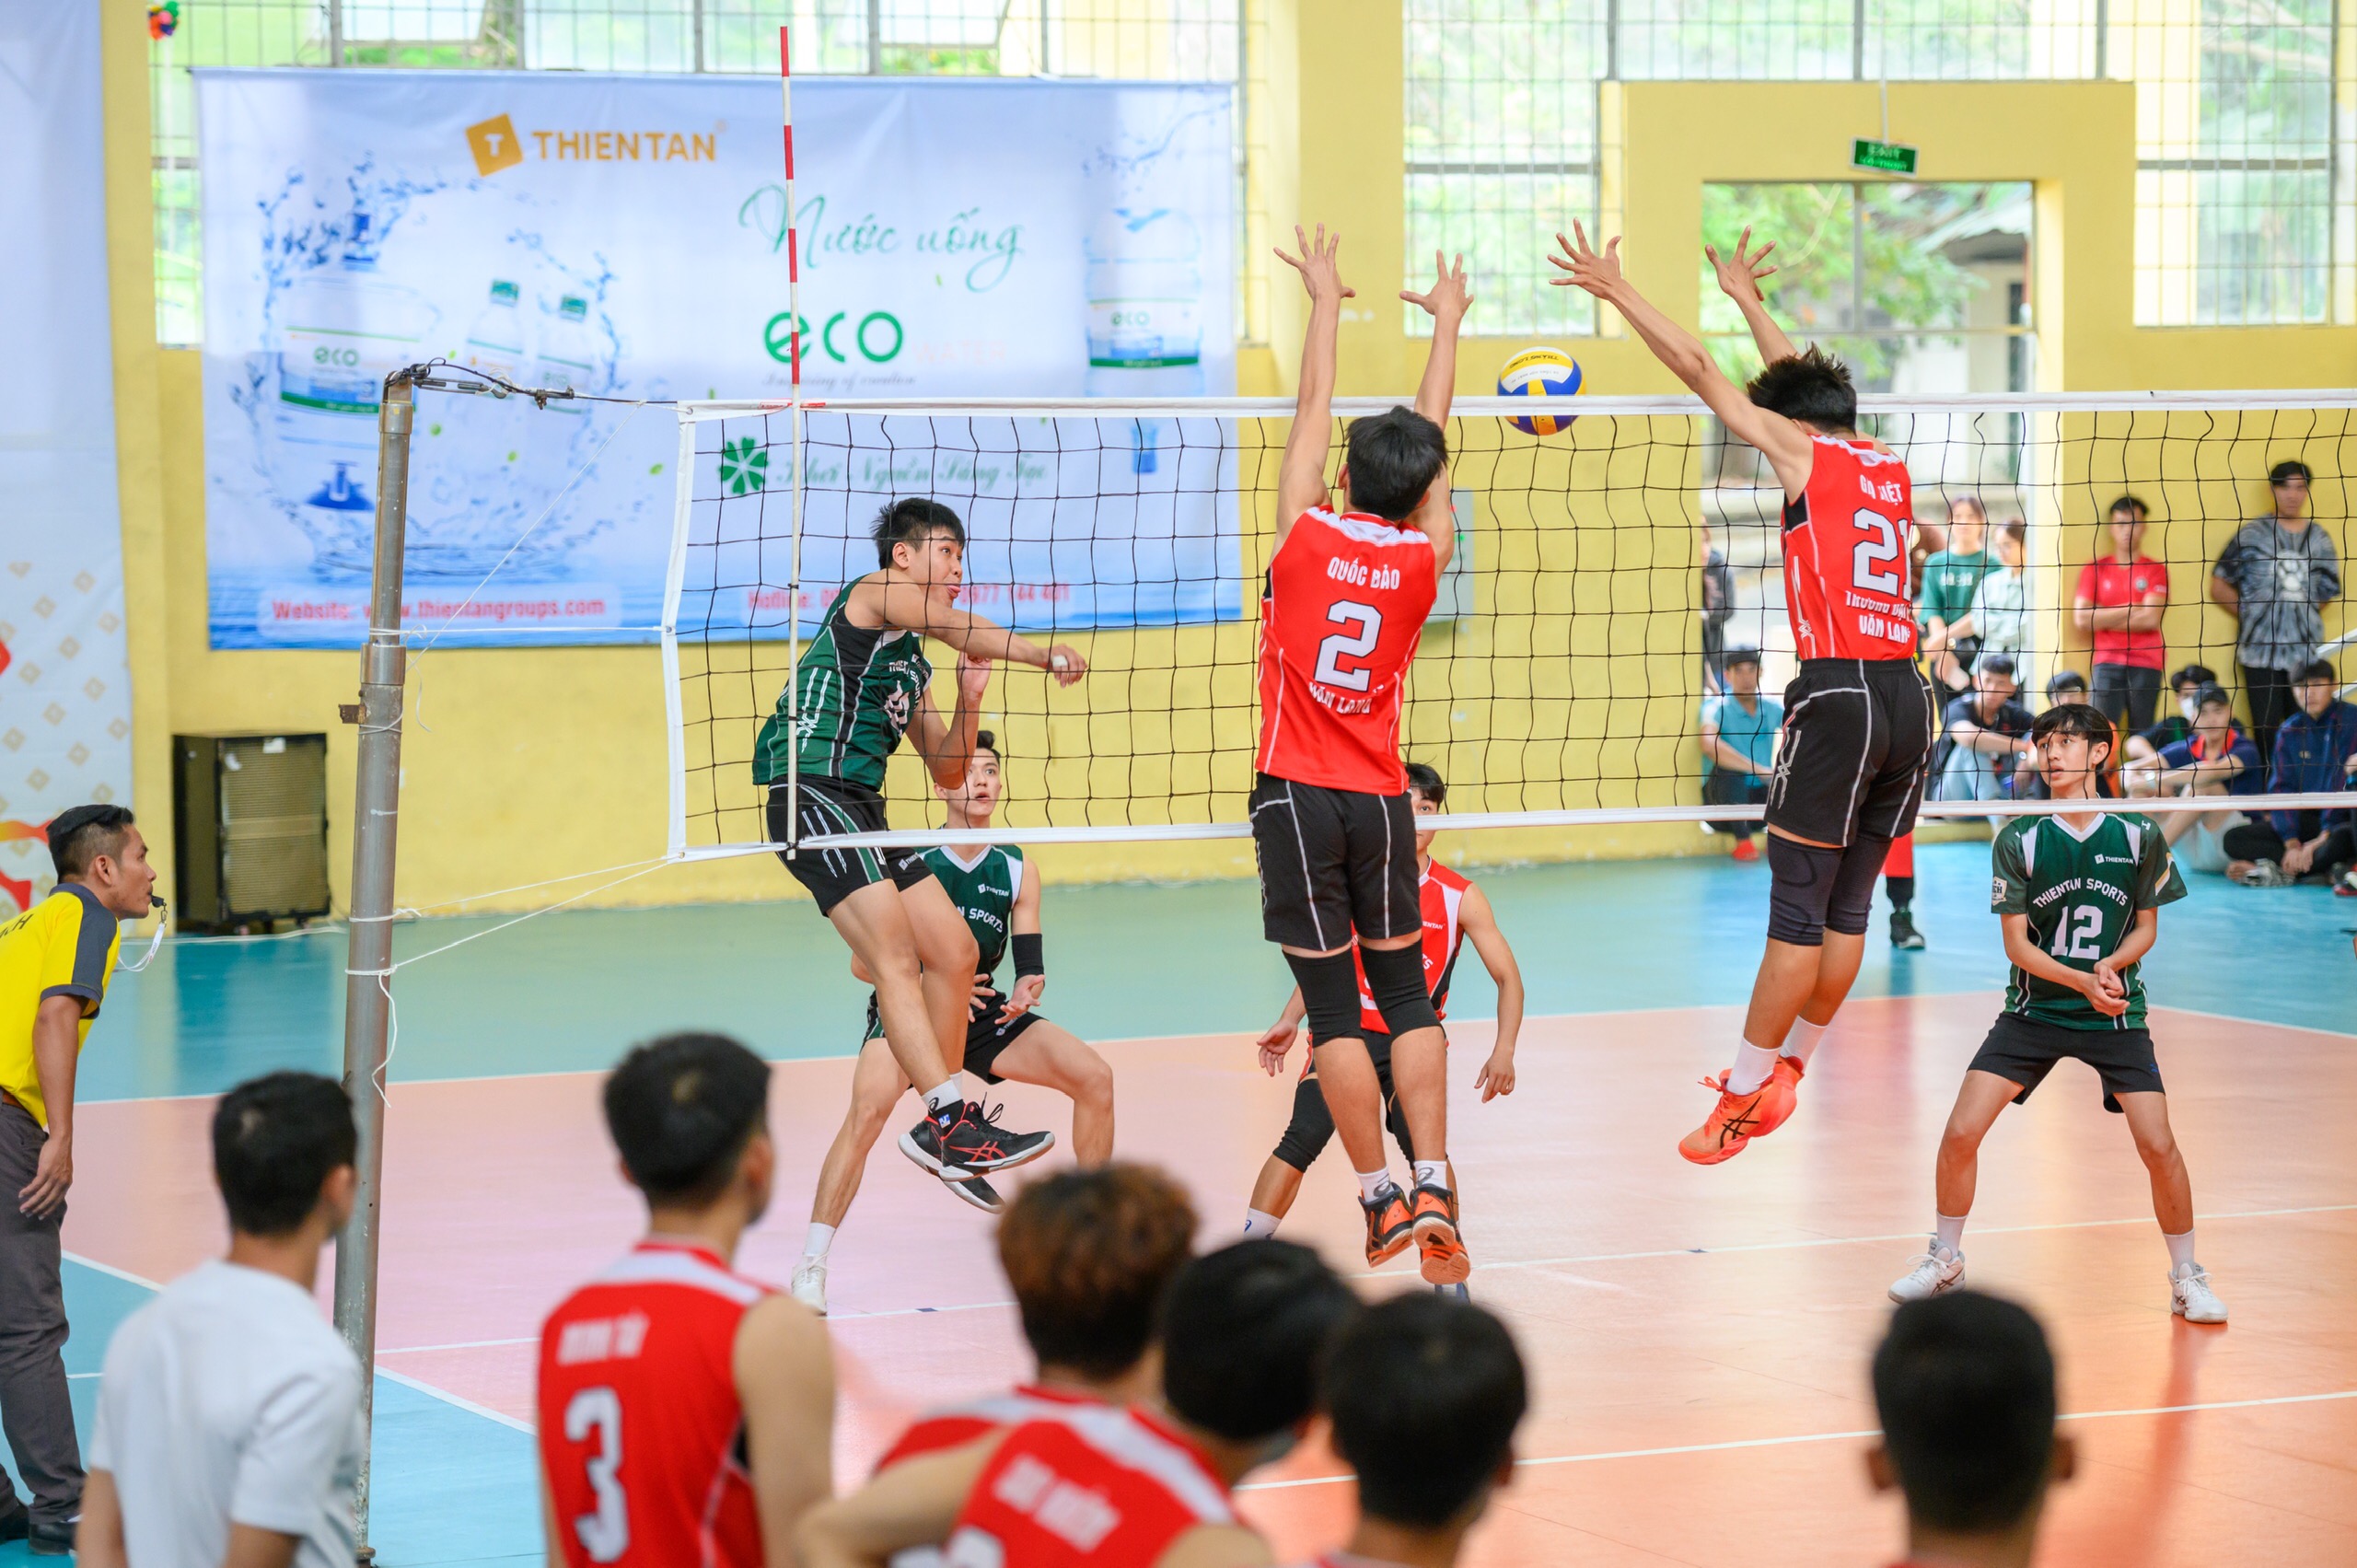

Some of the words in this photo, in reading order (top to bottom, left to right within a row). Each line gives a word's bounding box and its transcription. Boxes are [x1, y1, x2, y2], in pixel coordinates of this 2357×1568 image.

[531, 131, 715, 162] THIENTAN
[738, 183, 900, 269] Nước
[916, 207, 1027, 293] uống
[764, 311, 903, 364] eco
[314, 346, 360, 367] eco
[1852, 506, 1912, 601] 21
[1327, 557, 1368, 587] QUỐC
[1370, 564, 1400, 590] BẢO
[1859, 613, 1885, 639] VĂN
[1314, 598, 1384, 692] 2
[2105, 855, 2134, 865] THIENTAN
[2032, 877, 2082, 909] THIENTAN
[2086, 877, 2129, 907] SPORTS
[969, 907, 1004, 933] SPORTS
[2050, 904, 2103, 960] 12
[563, 1384, 631, 1563] 3
